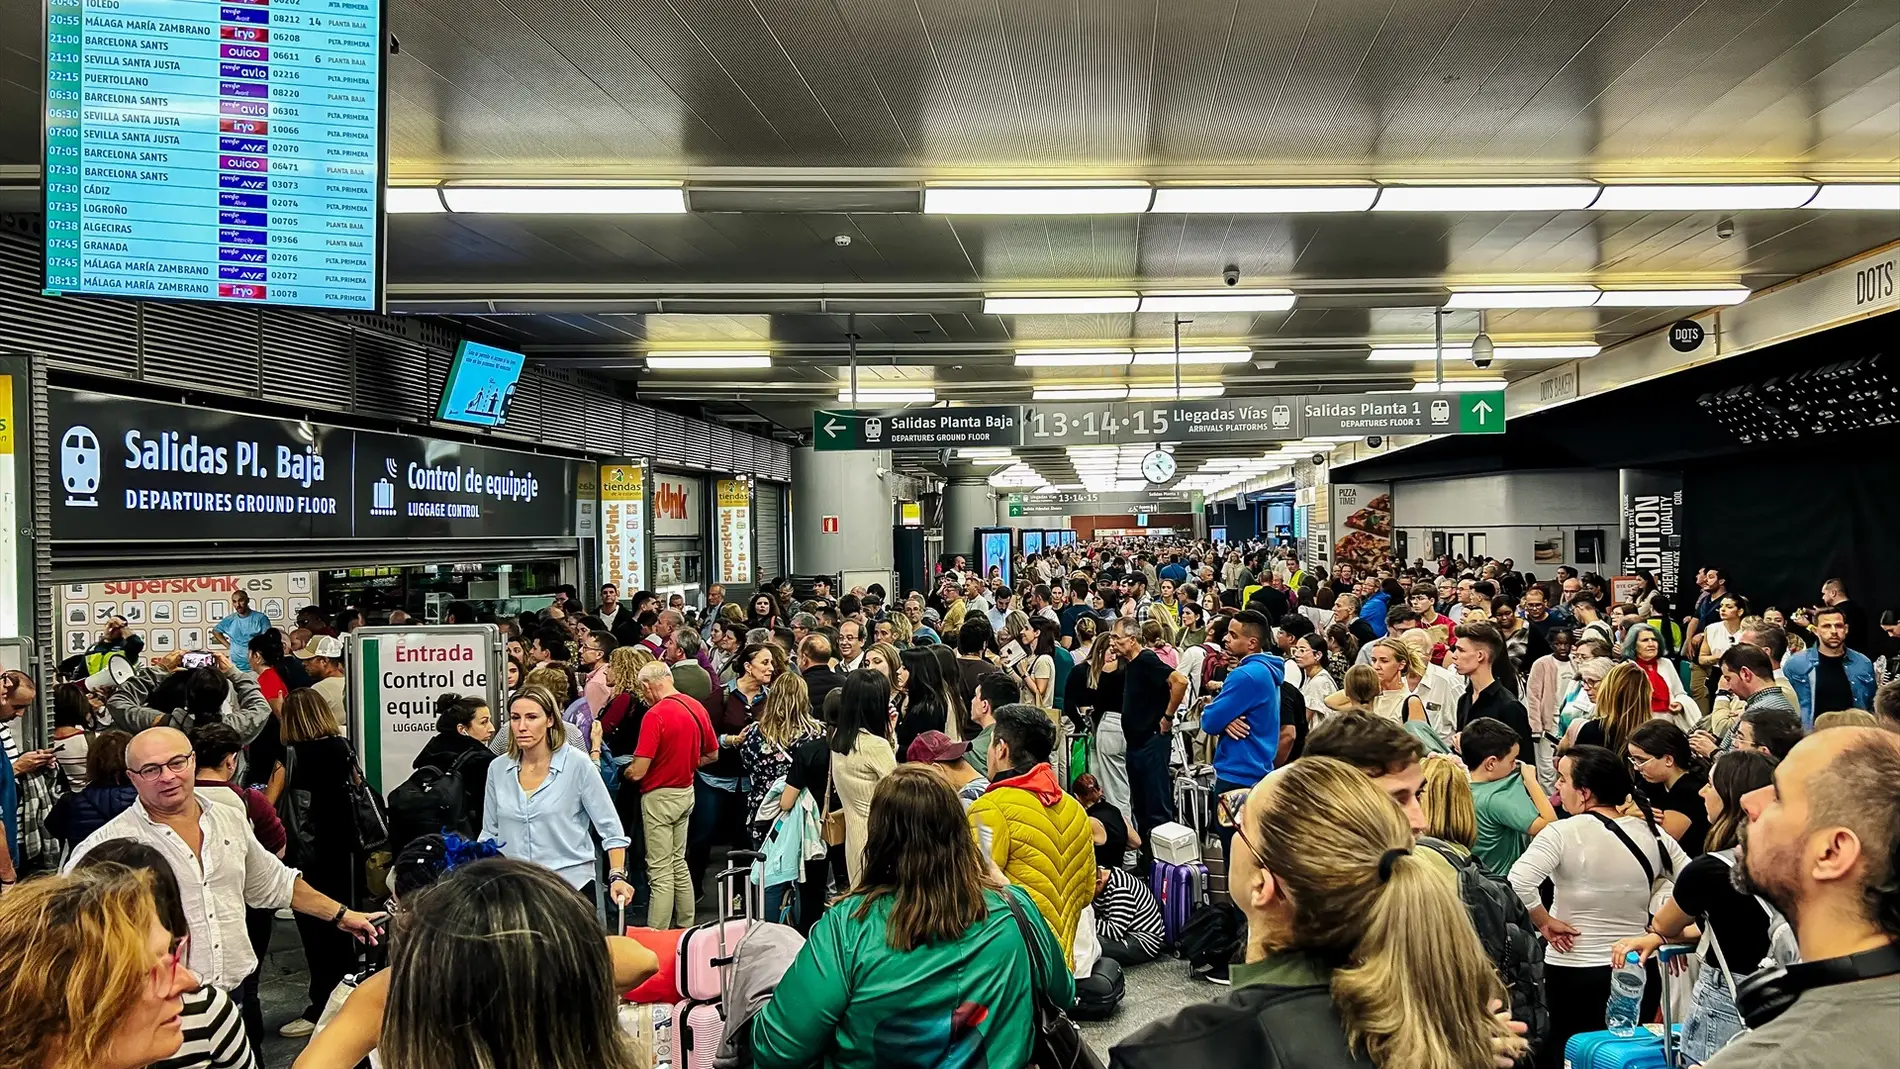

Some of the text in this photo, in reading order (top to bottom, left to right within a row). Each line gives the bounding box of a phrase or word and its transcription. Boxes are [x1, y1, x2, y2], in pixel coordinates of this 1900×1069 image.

[86, 0, 120, 9] TOLEDO
[274, 15, 300, 24] 08212
[309, 18, 321, 26] 14
[50, 16, 79, 25] 20:55
[85, 17, 123, 28] MÁLAGA
[127, 20, 156, 31] MARÍA
[159, 23, 210, 35] ZAMBRANO
[234, 28, 255, 40] iryo
[274, 33, 300, 42] 06208
[50, 34, 79, 44] 21:00
[85, 36, 137, 48] BARCELONA
[140, 40, 168, 50] SANTS
[273, 52, 299, 61] 06611
[315, 55, 321, 63] 6
[50, 53, 79, 63] 21:10
[84, 55, 119, 65] SEVILLA
[122, 57, 151, 68] SANTA
[153, 60, 180, 70] JUSTA
[241, 67, 266, 78] avlo
[273, 70, 300, 79] 02216
[50, 71, 299, 97] 22:15 PUERTOLLANO 08220
[50, 90, 78, 100] 06:30
[84, 92, 137, 104] BARCELONA
[140, 96, 168, 106] SANTS
[241, 105, 266, 115] avlo
[273, 107, 299, 116] 06301
[50, 109, 78, 118] 06:30
[84, 111, 119, 122] SEVILLA
[122, 114, 150, 124] SANTA
[153, 116, 180, 126] JUSTA
[234, 121, 254, 133] iryo
[273, 126, 299, 134] 10066
[49, 128, 78, 137] 07:00
[84, 129, 119, 140] SEVILLA
[122, 132, 150, 142] SANTA
[153, 134, 180, 145] JUSTA
[241, 144, 266, 152] AVE
[272, 143, 298, 152] 02070
[49, 146, 78, 156] 07:05
[84, 148, 137, 160] BARCELONA
[140, 152, 168, 162] SANTS
[272, 162, 298, 171] 06471
[49, 165, 78, 174] 07:30
[84, 168, 137, 179] BARCELONA
[140, 171, 168, 181] SANTS
[272, 181, 298, 189] 03073
[49, 183, 78, 193] 07:30
[84, 184, 110, 195] CÁDIZ
[272, 199, 298, 208] 02074
[49, 202, 78, 212] 07:35
[84, 204, 128, 214] LOGROÑO
[272, 217, 298, 226] 00705
[49, 220, 78, 230] 07:38
[84, 222, 132, 234] ALGECIRAS
[272, 235, 298, 244] 09366
[49, 239, 78, 248] 07:45
[84, 241, 128, 252] GRANADA
[240, 254, 265, 262] AVE
[272, 254, 298, 262] 02076
[49, 257, 78, 267] 07:45
[84, 258, 122, 270] MÁLAGA
[125, 261, 155, 272] MARÍA
[158, 264, 209, 275] ZAMBRANO
[240, 272, 265, 280] AVE
[272, 272, 298, 280] 02072
[49, 276, 78, 286] 08:13
[84, 277, 122, 288] MÁLAGA
[125, 279, 155, 290] MARÍA
[157, 282, 209, 293] ZAMBRANO
[232, 286, 252, 296] iryo
[272, 290, 297, 298] 10078
[1856, 260, 1894, 305] DOTS
[1676, 328, 1698, 340] DOTS
[1174, 405, 1268, 424] Llegadas Vías
[1305, 402, 1421, 417] Salidas Planta 1
[891, 415, 1014, 430] Salidas Planta Baja
[1188, 423, 1268, 433] ARRIVALS PLATFORMS
[1340, 418, 1421, 428] DEPARTURES FLOOR 1
[891, 433, 990, 442] DEPARTURES GROUND FLOOR
[125, 429, 324, 488] Salidas Pl. Baja
[408, 462, 538, 502] Control de equipaje
[126, 489, 336, 514] DEPARTURES GROUND FLOOR
[1674, 490, 1682, 505] COOL
[408, 502, 480, 518] LUGGAGE CONTROL
[1660, 496, 1673, 535] QUALITY
[1662, 551, 1674, 593] PREMIUM
[396, 644, 473, 662] Entrada
[384, 670, 486, 688] Control de
[387, 696, 440, 718] equip
[393, 723, 435, 732] LUGGAGE
